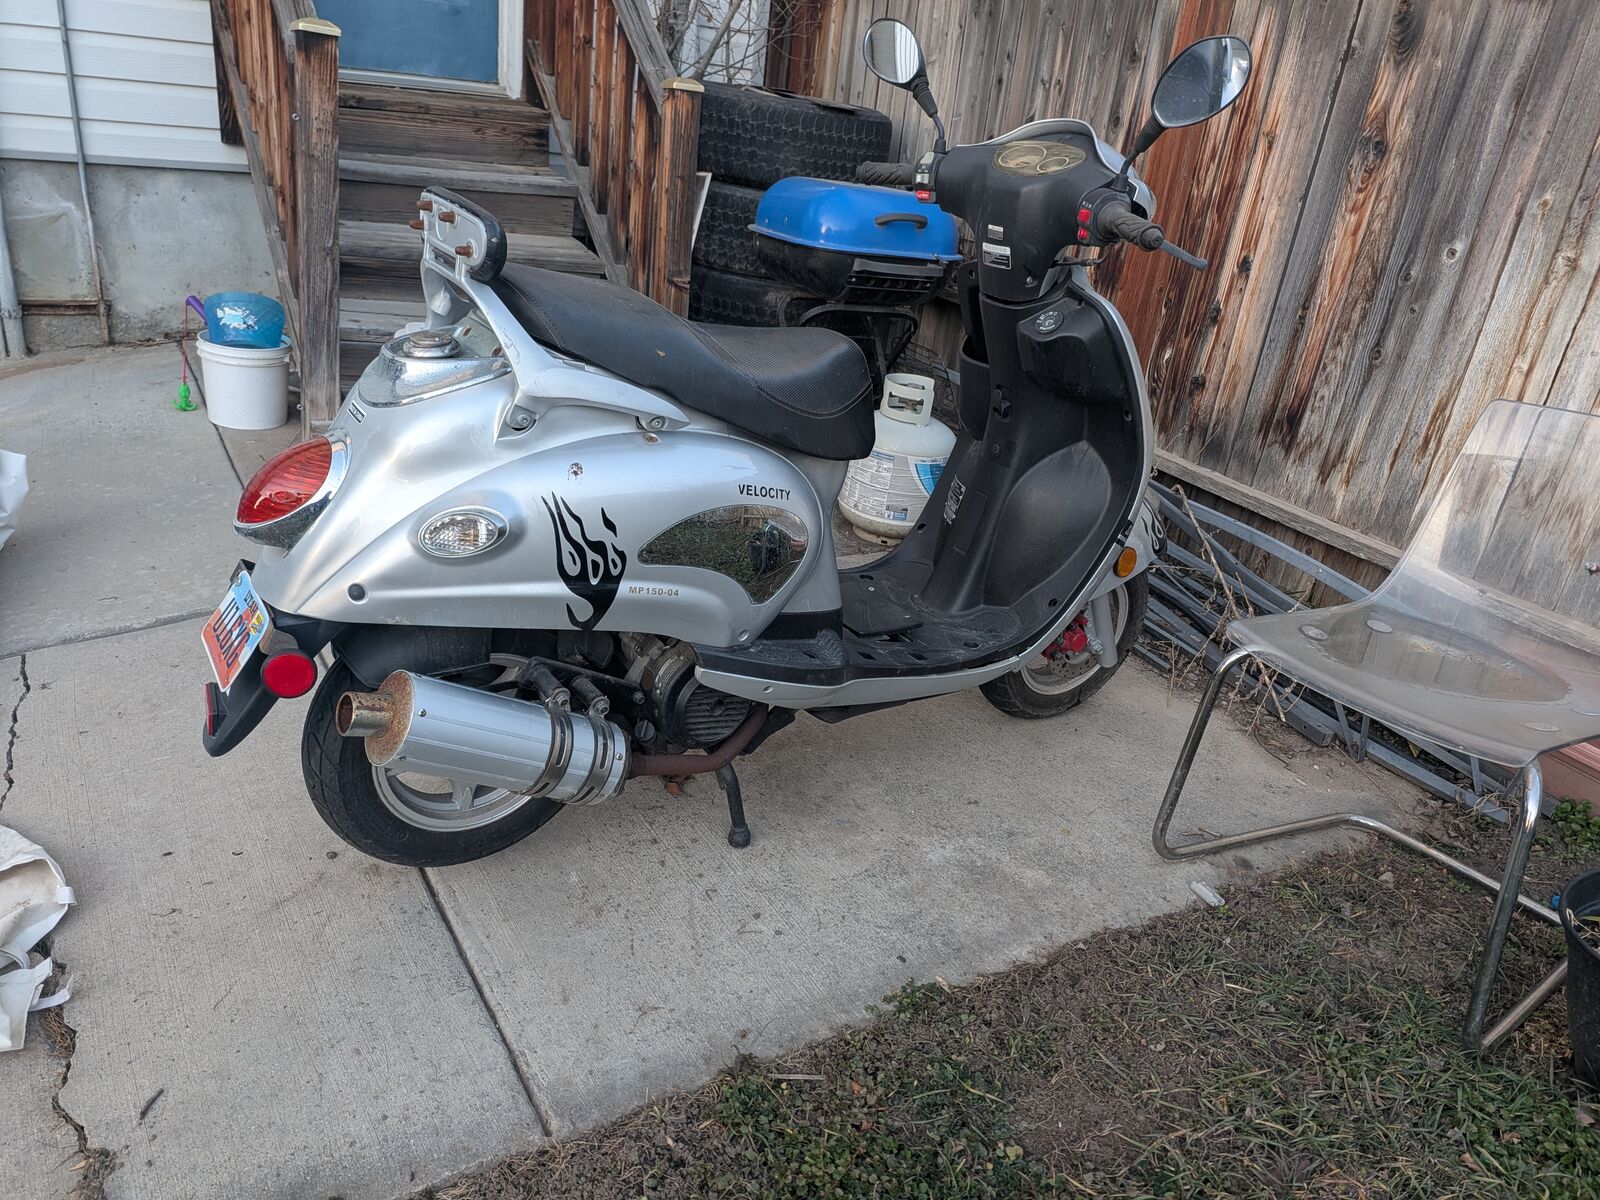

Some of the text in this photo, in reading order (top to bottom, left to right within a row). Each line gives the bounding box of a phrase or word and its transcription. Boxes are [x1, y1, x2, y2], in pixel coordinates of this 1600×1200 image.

[738, 484, 791, 500] VELOCITY
[628, 586, 679, 597] MP150-04
[243, 590, 259, 618] UTAH
